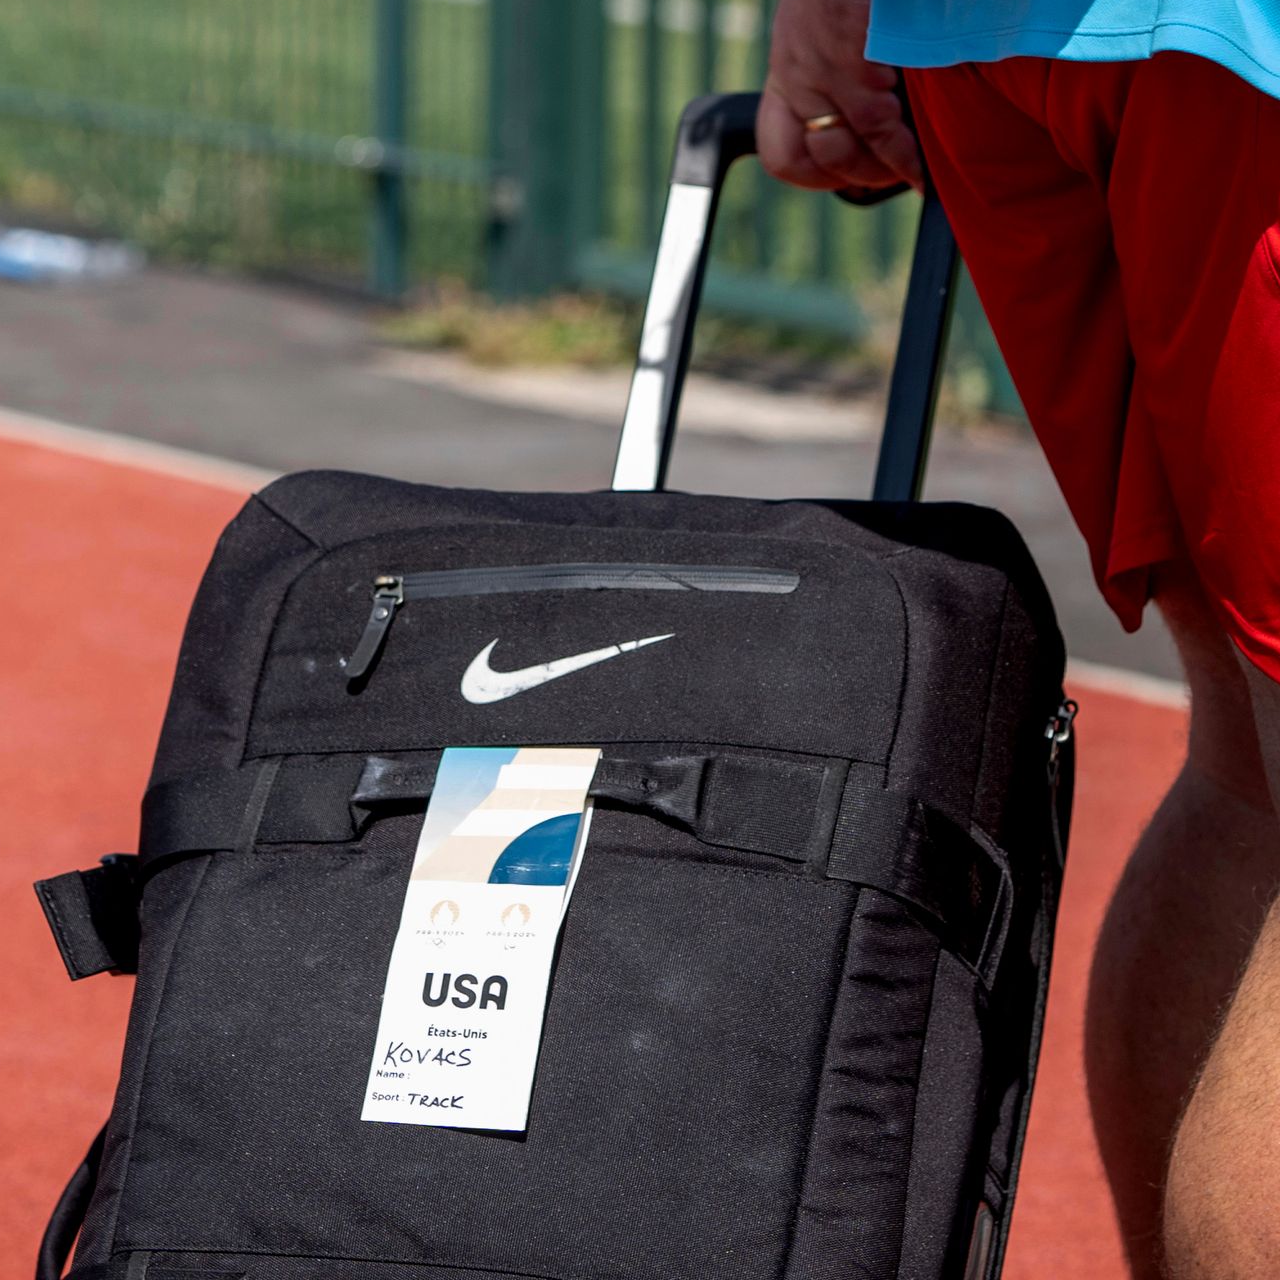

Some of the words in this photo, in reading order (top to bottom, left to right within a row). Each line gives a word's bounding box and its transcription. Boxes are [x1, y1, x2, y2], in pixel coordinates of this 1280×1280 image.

[422, 972, 509, 1011] USA
[427, 1024, 488, 1039] États-Unis
[383, 1041, 472, 1068] KOVACS
[408, 1093, 464, 1109] TRACK
